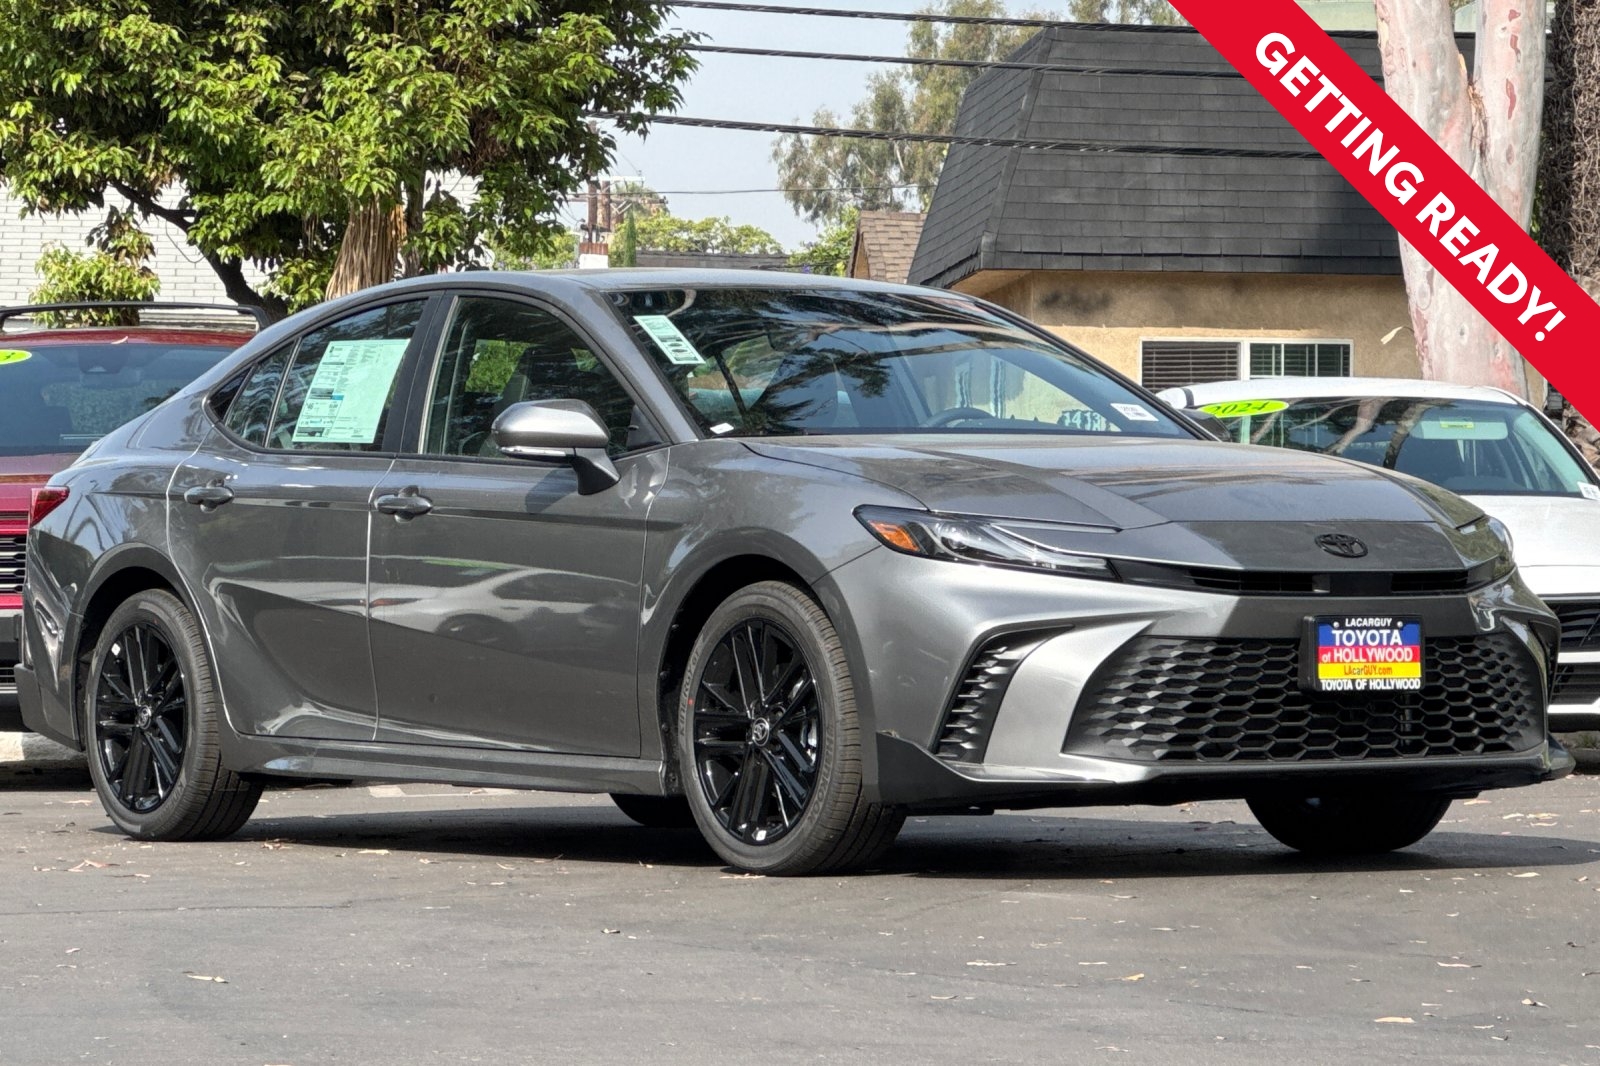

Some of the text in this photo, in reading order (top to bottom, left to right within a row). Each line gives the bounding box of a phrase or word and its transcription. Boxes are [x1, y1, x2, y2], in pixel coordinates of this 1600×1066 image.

[1345, 618, 1392, 627] LACARGUY
[1332, 629, 1402, 646] TOYOTA
[1322, 648, 1413, 662] of HOLLYWOOD
[1320, 678, 1420, 690] TOYOTA OF HOLLYWOOD
